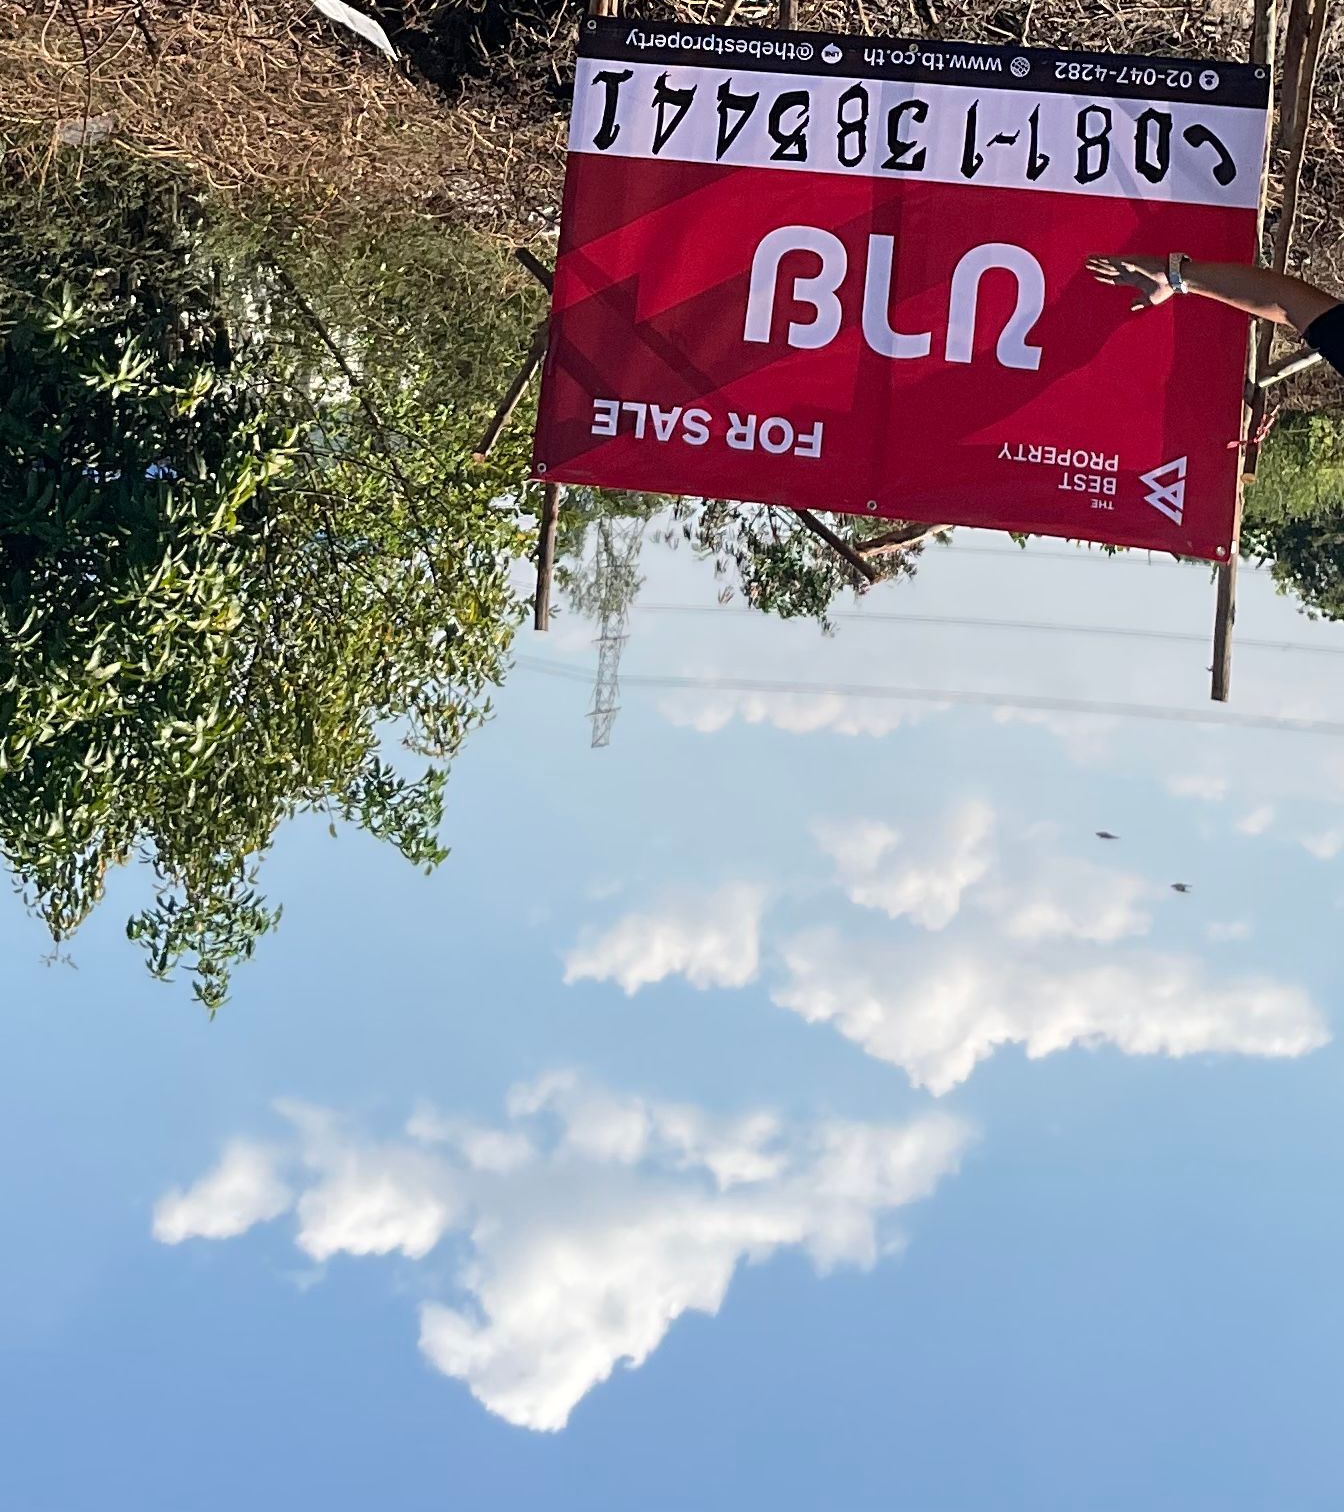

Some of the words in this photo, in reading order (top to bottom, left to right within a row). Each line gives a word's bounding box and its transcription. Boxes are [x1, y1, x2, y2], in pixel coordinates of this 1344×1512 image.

[625, 28, 814, 60] @thebestproperty
[863, 47, 1003, 72] www.tb.co.th
[1055, 61, 1193, 87] 02-047-4282
[743, 225, 1046, 370] ขาย
[591, 398, 712, 445] SALE
[727, 412, 824, 458] FOR
[998, 442, 1119, 471] PROPERTY
[1058, 472, 1117, 495] BEST
[1091, 498, 1114, 510] THE
